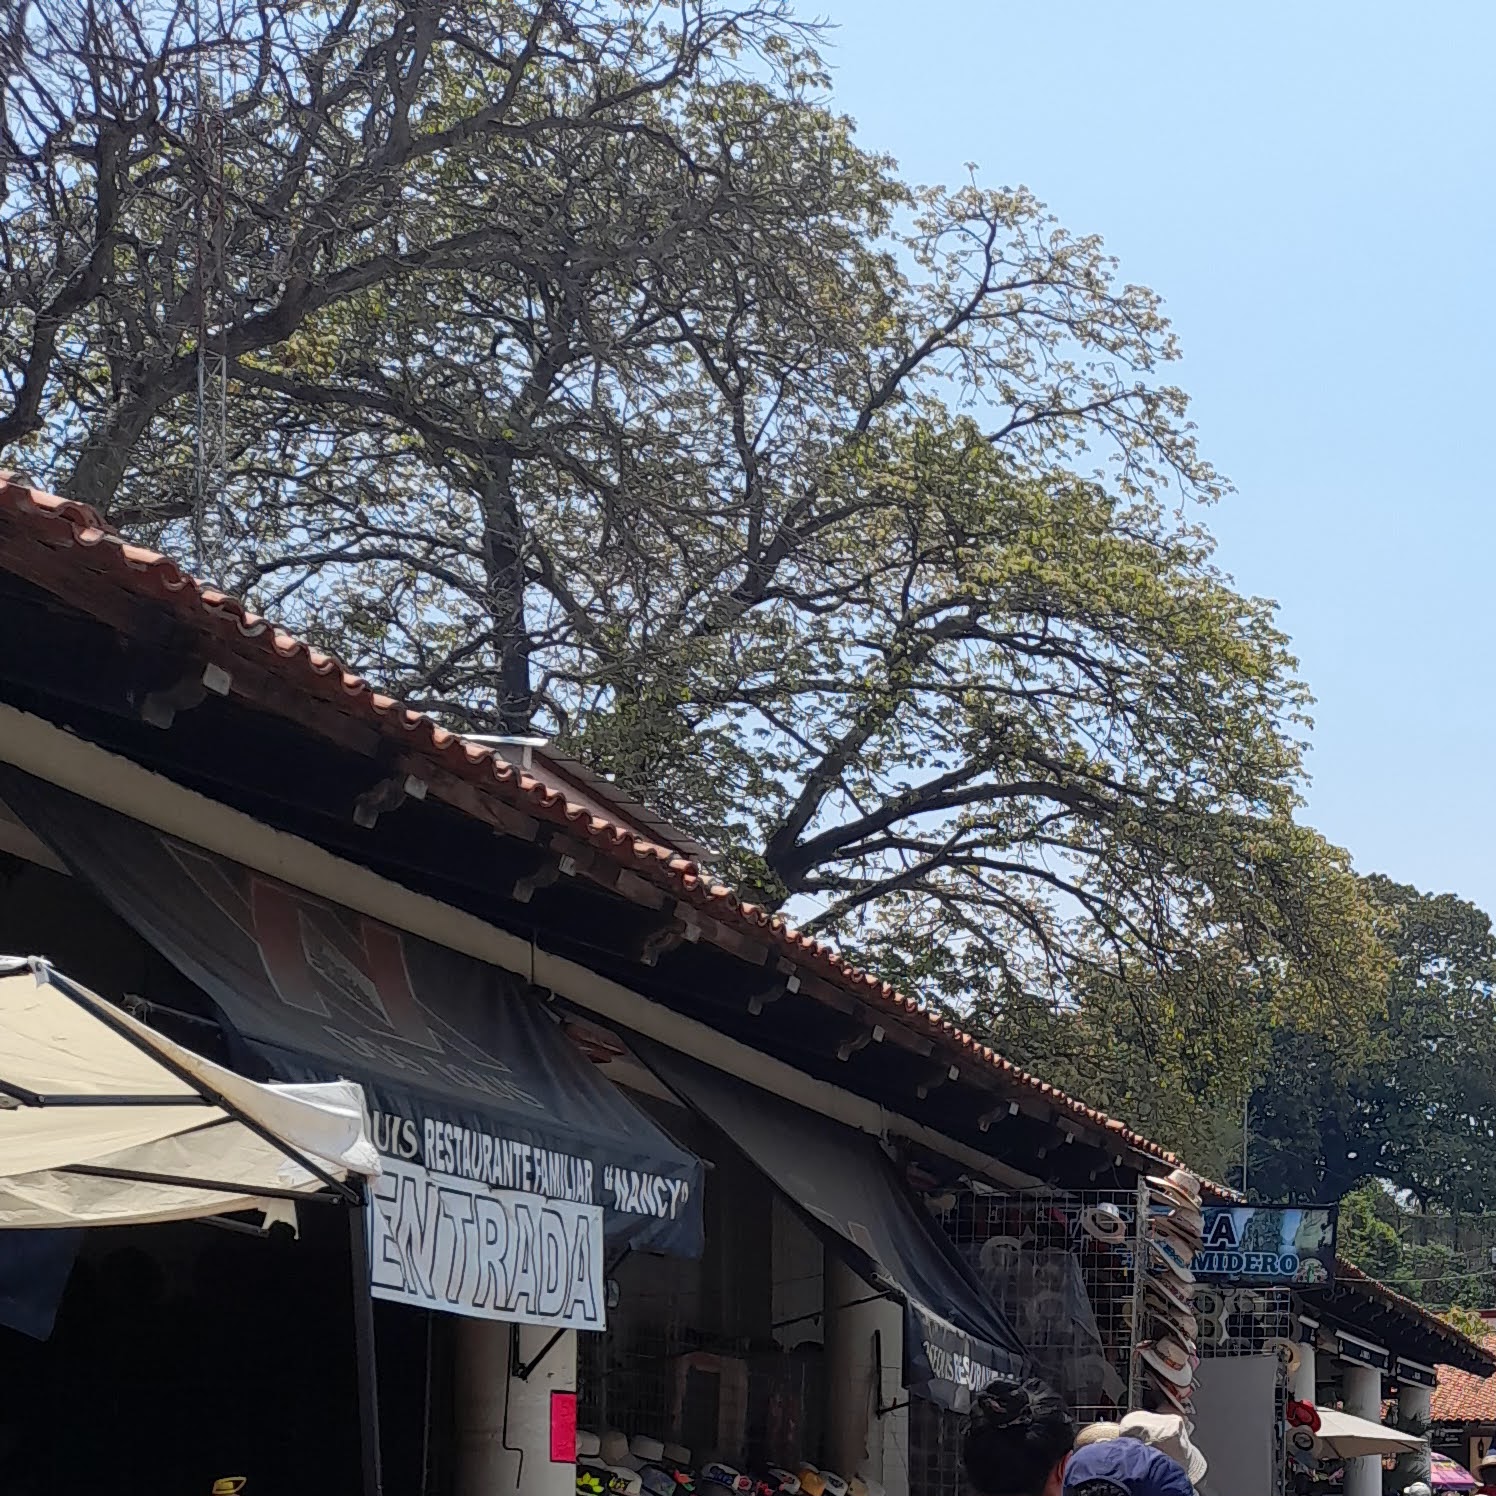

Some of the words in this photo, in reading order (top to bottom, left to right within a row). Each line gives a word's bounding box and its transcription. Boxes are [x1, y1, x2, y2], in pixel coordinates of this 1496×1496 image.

[373, 1110, 418, 1159] UIS
[424, 1118, 532, 1192] RESTAURANTE
[533, 1148, 594, 1204] FAMILIAR
[370, 1170, 598, 1322] ENTRADA
[1190, 1251, 1300, 1276] MIDERO
